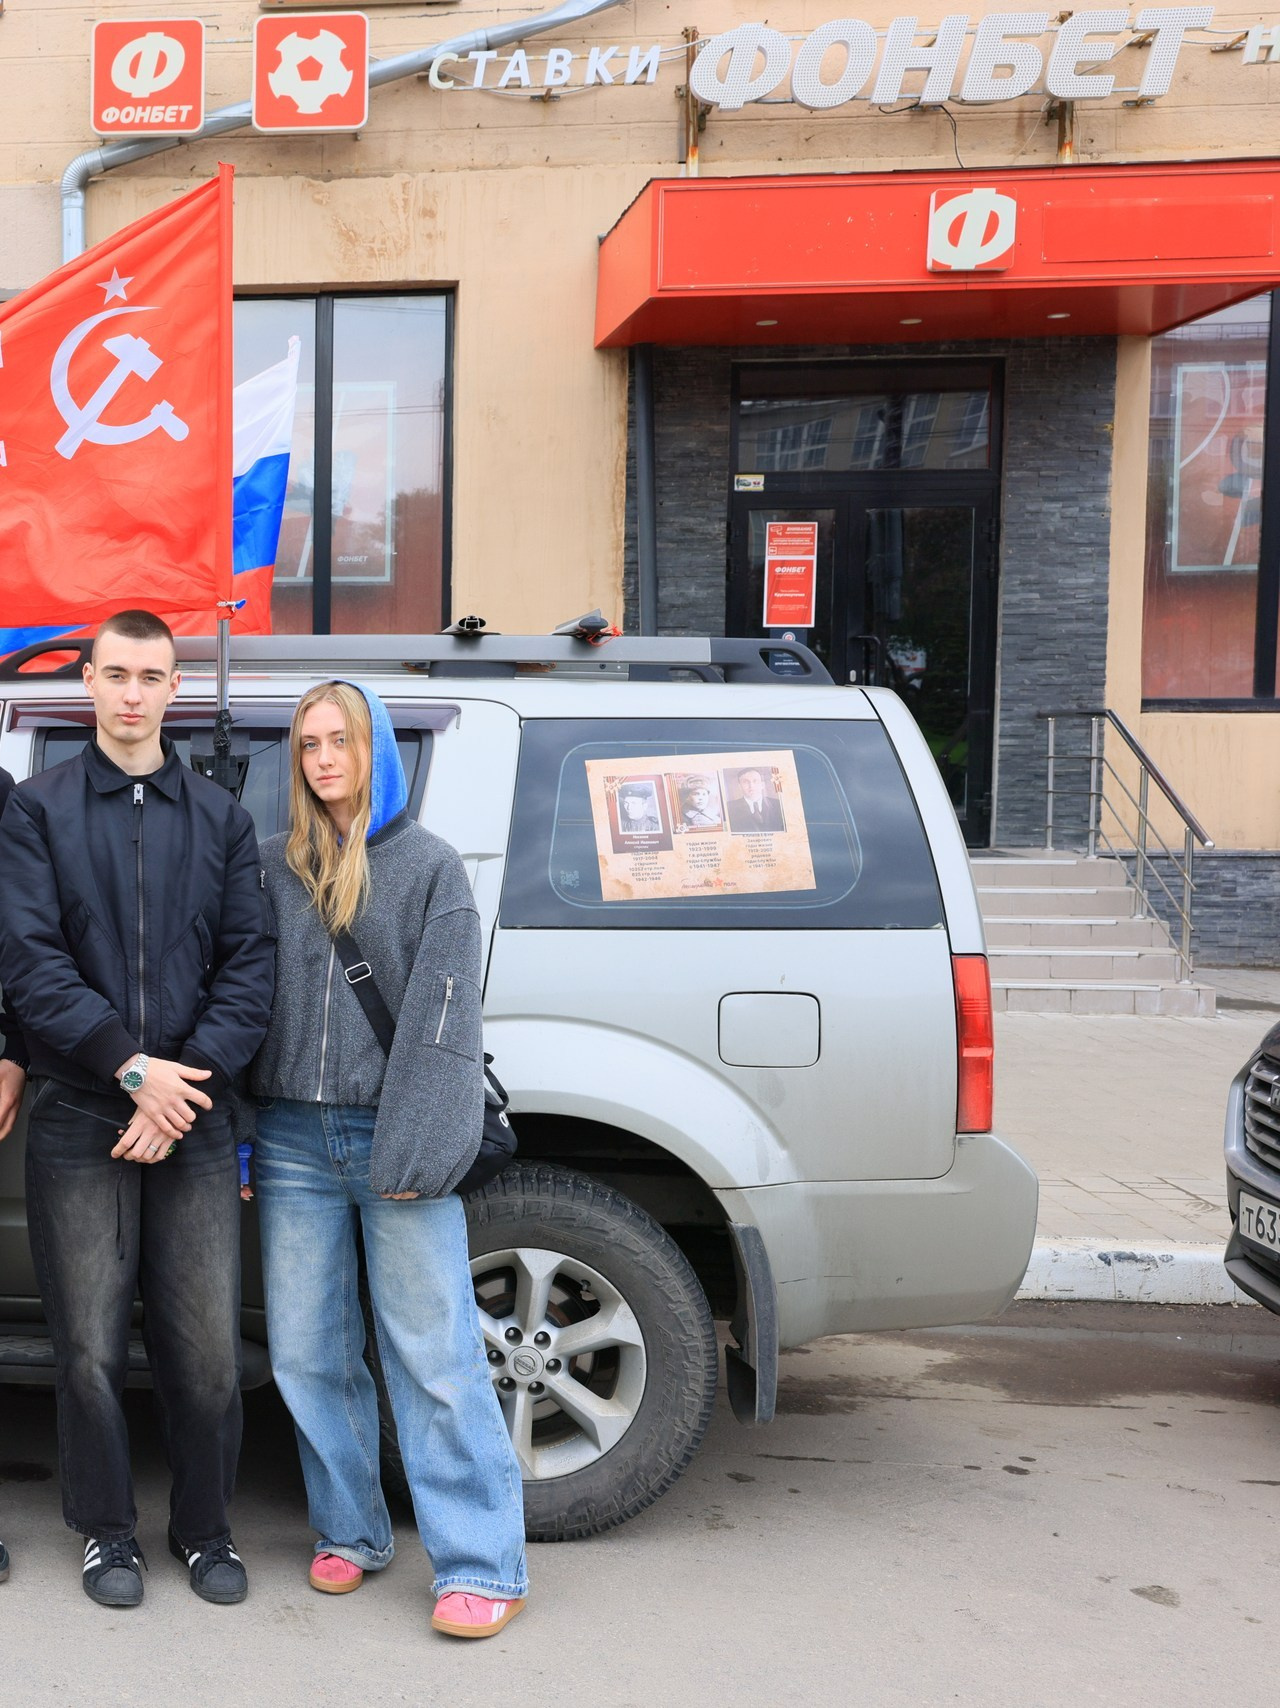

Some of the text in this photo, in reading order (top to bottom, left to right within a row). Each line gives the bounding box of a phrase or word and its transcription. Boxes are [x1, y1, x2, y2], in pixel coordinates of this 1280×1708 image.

[111, 32, 185, 98] Ф
[428, 45, 661, 90] СТАВКИ
[689, 5, 1214, 111] ФОНБЕТ
[1242, 24, 1280, 64] Н
[101, 105, 193, 124] ФОНБЕТ
[929, 187, 1016, 270] Ф
